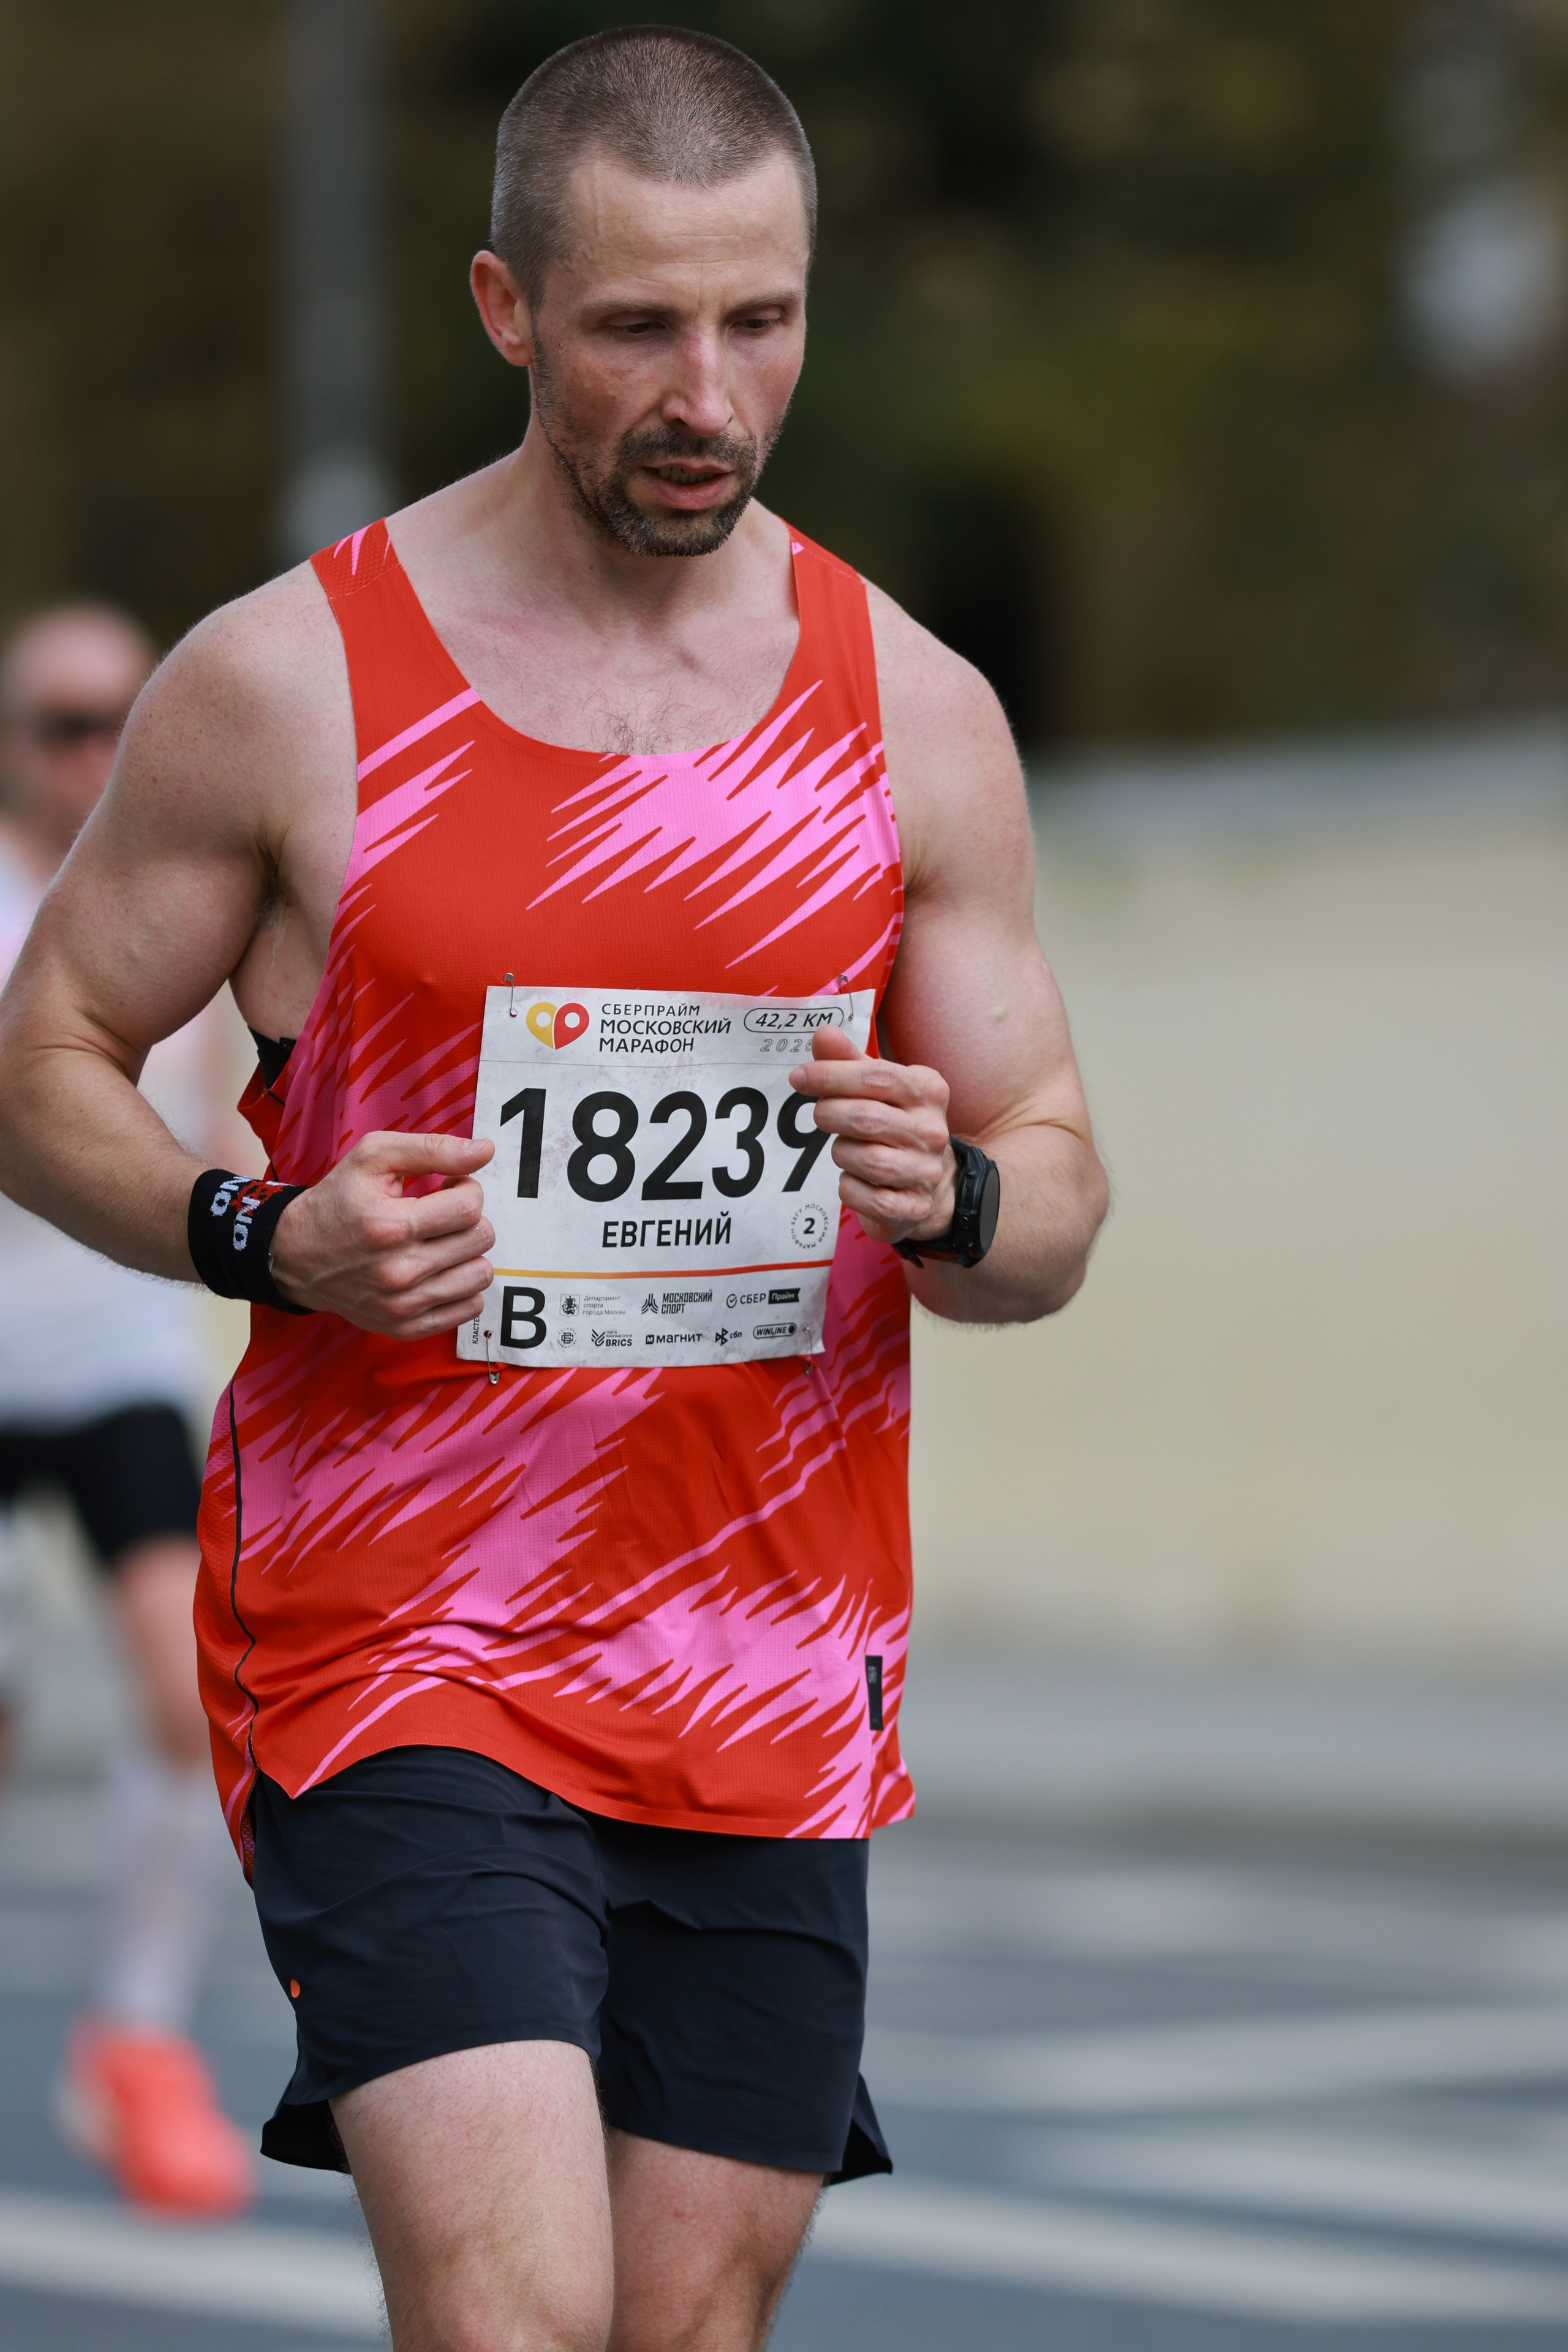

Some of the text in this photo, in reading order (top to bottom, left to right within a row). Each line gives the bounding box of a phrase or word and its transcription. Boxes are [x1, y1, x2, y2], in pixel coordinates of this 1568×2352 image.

[601, 1003, 700, 1016] СБЕРПРАЙМ
[600, 1017, 731, 1035] МОСКОВСКИЙ
[755, 1012, 797, 1030] 42,2
[599, 1038, 695, 1054] МАРАФОН
[500, 1086, 832, 1202] 18239
[791, 1208, 802, 1226] БЕГУ
[601, 1211, 731, 1248] ЕВГЕНИЙ
[803, 1217, 815, 1235] 2
[790, 1228, 816, 1250] МАРАФОН
[662, 1289, 713, 1303] МОСКОВСКИЙ
[739, 1291, 794, 1305] СБЕР Прайм
[661, 1303, 685, 1314] СПОРТ
[756, 1326, 788, 1336] WINLINE
[605, 1338, 633, 1347] BRICS
